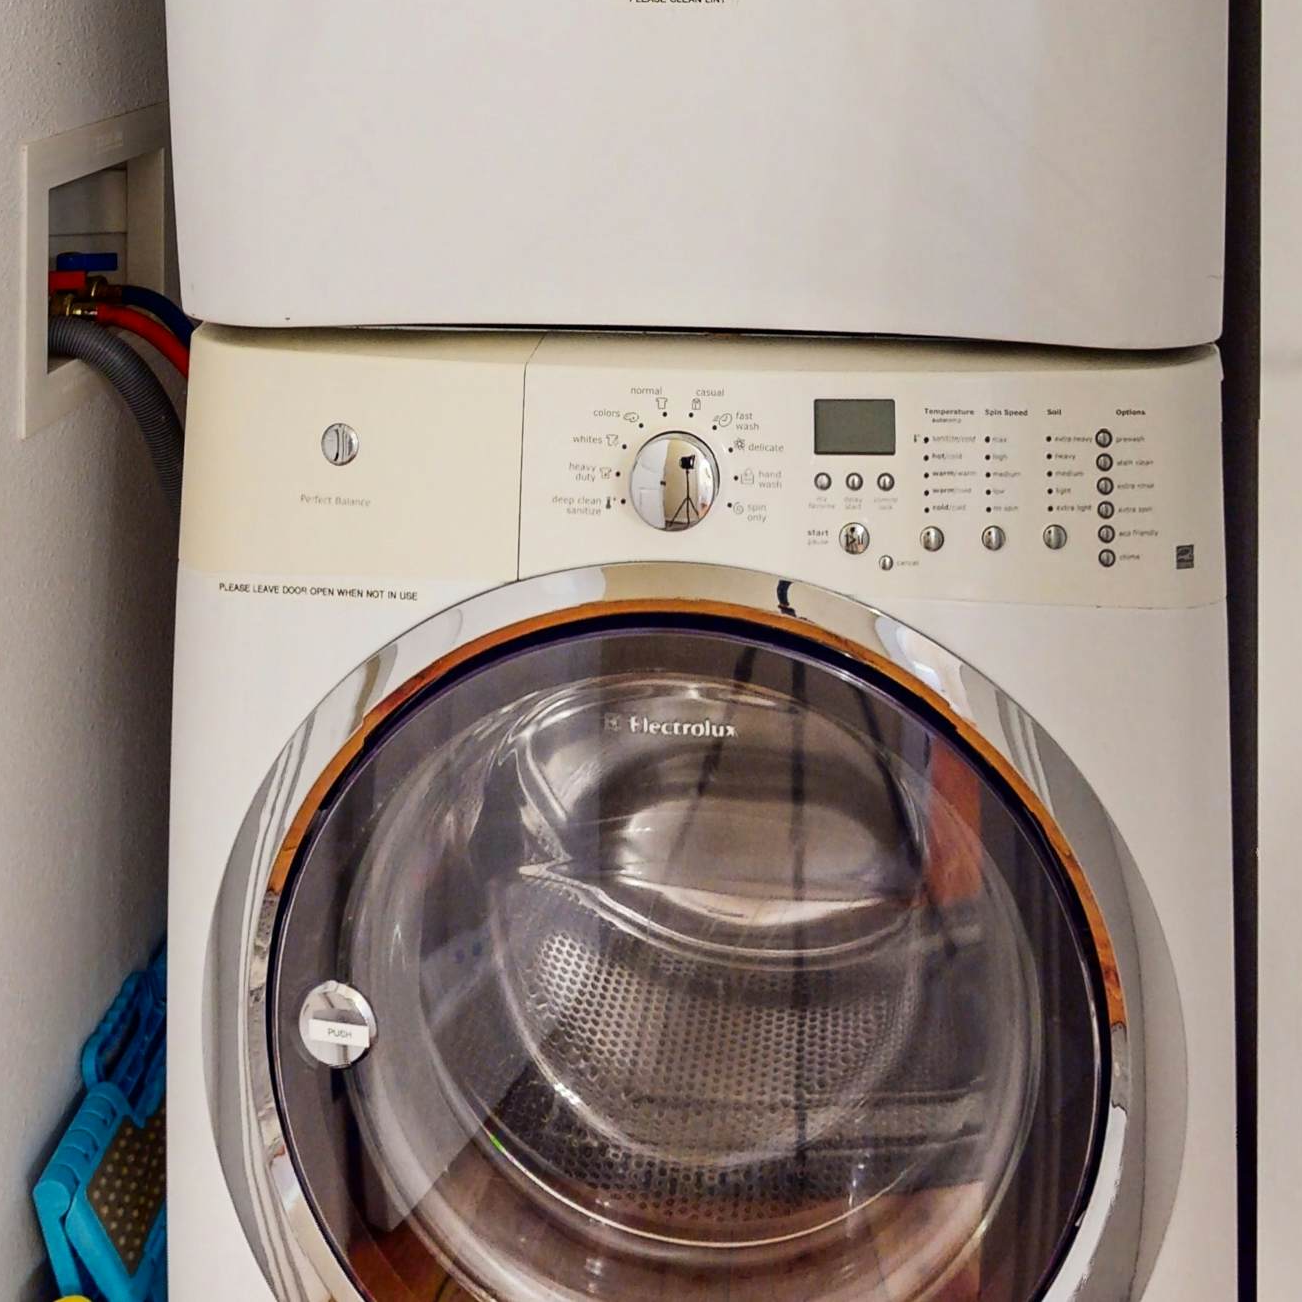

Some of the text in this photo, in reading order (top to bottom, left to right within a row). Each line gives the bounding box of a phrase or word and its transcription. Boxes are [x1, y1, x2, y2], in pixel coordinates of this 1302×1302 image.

[630, 386, 663, 395] normal
[696, 388, 725, 397] casual
[593, 409, 621, 418] colors
[735, 411, 753, 420] fast
[924, 407, 975, 416] Temperature
[985, 408, 1029, 417] Spin Speed
[1115, 408, 1146, 417] Options
[735, 422, 760, 431] wash
[572, 435, 602, 444] whites
[748, 443, 784, 452] delicate
[569, 461, 597, 472] heavy
[575, 473, 597, 483] duty
[758, 469, 782, 478] hand
[758, 480, 783, 489] wash
[299, 493, 371, 508] Perfect Balance
[552, 495, 602, 506] deep clean
[566, 507, 602, 516] sanitize
[747, 502, 767, 512] spin
[747, 512, 768, 523] only
[807, 528, 829, 537] start
[219, 582, 419, 601] PLEASE LEAVE DOOR OPEN WHEN NOT IN USE
[629, 715, 739, 738] Electrolux
